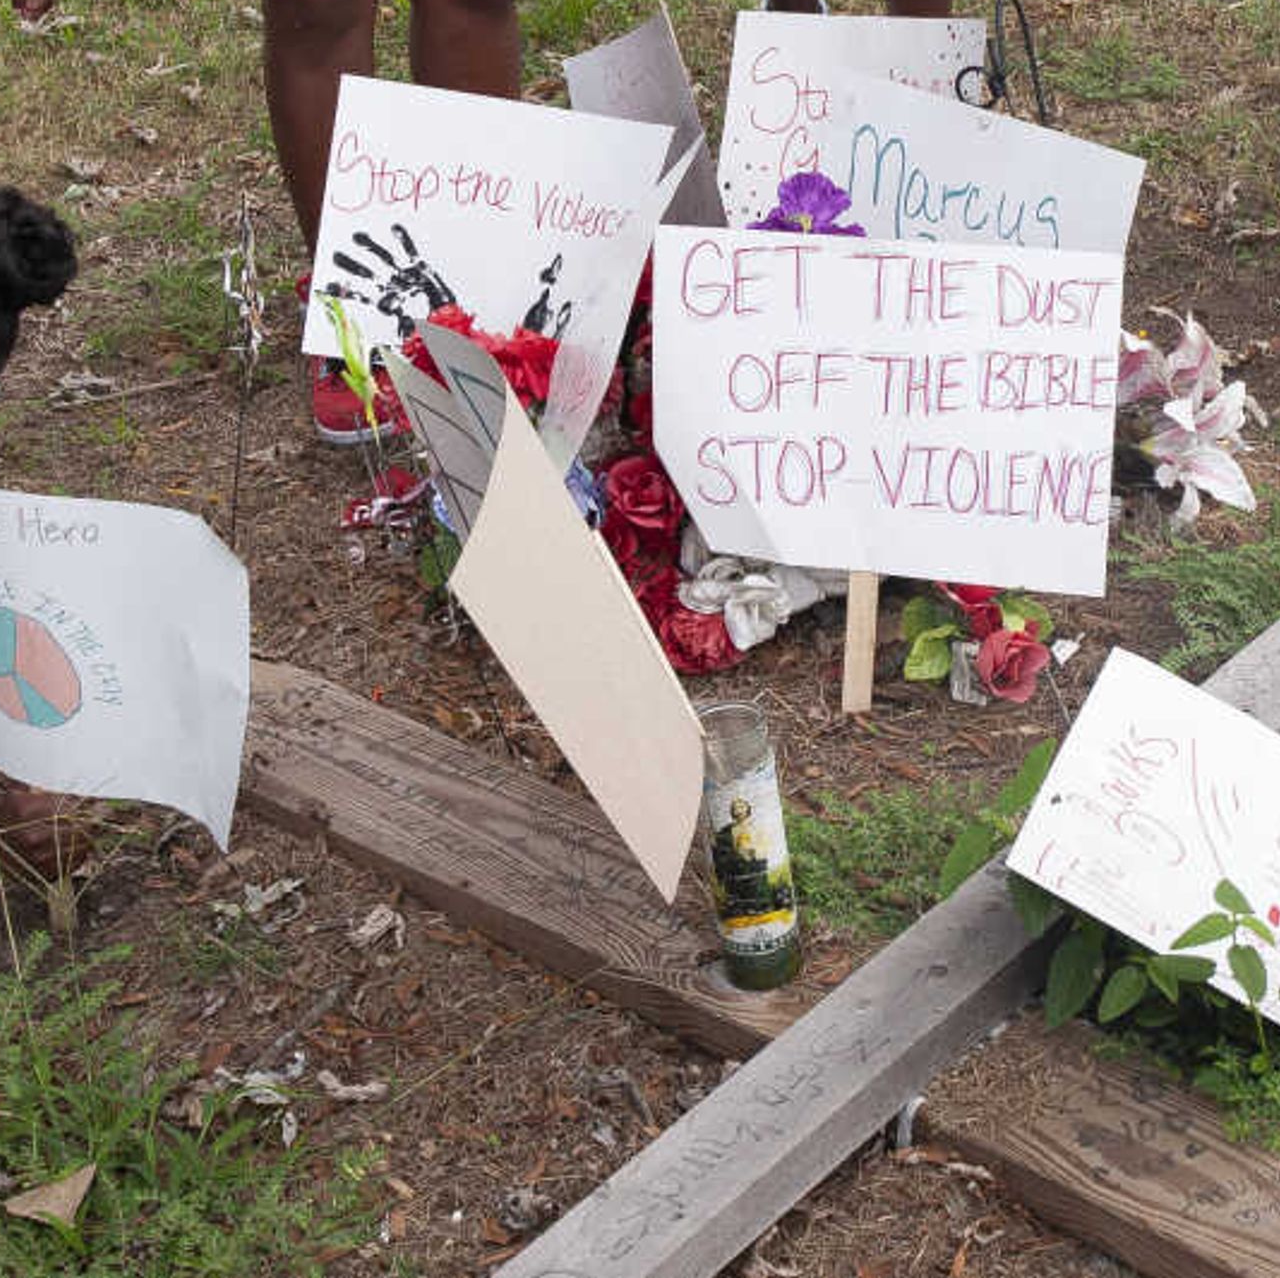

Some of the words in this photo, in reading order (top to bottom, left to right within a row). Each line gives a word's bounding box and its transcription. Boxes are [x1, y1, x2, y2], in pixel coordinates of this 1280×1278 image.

[329, 131, 441, 212] Stop
[449, 163, 516, 211] the
[681, 239, 822, 317] GET
[844, 253, 981, 322] THE
[728, 351, 853, 412] OFF
[866, 354, 968, 416] THE
[979, 351, 1118, 410] BIBLE
[697, 435, 847, 506] STOP
[873, 442, 1111, 525] VIOLENCE
[17, 507, 102, 547] Hero
